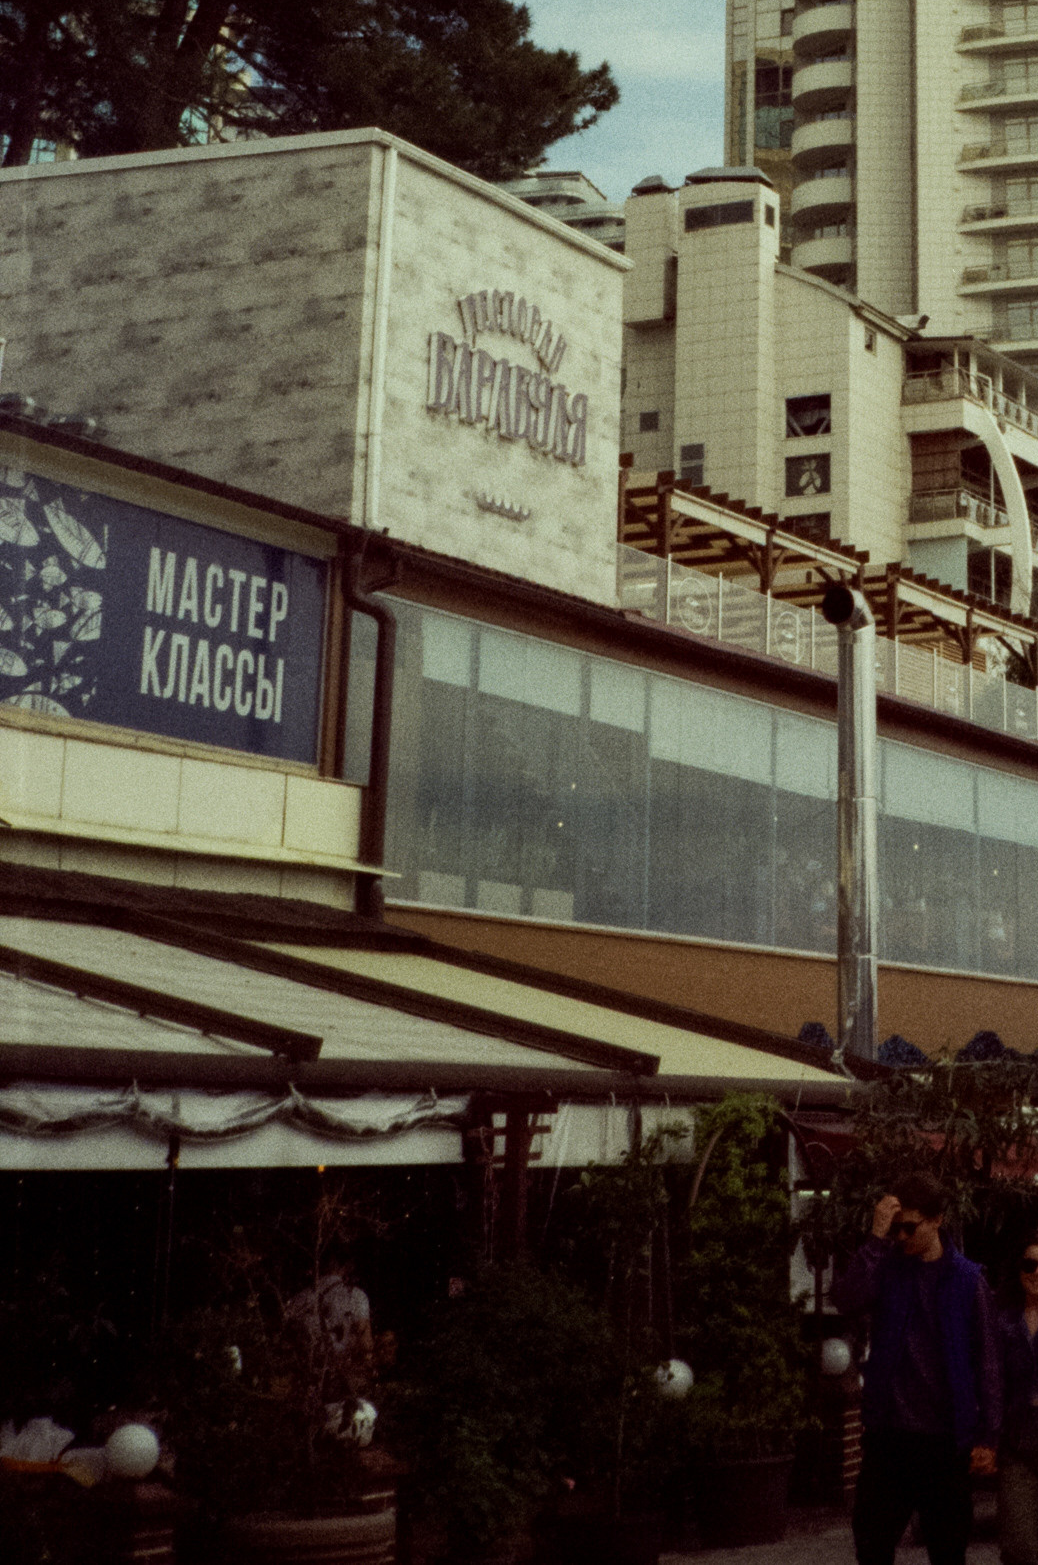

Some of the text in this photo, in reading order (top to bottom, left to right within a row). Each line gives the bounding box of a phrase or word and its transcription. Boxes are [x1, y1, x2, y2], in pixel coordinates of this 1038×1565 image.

[427, 331, 589, 469] БАРАБУЛЯ
[146, 546, 289, 642] МАСТЕР
[140, 626, 285, 723] КЛАССЫ
